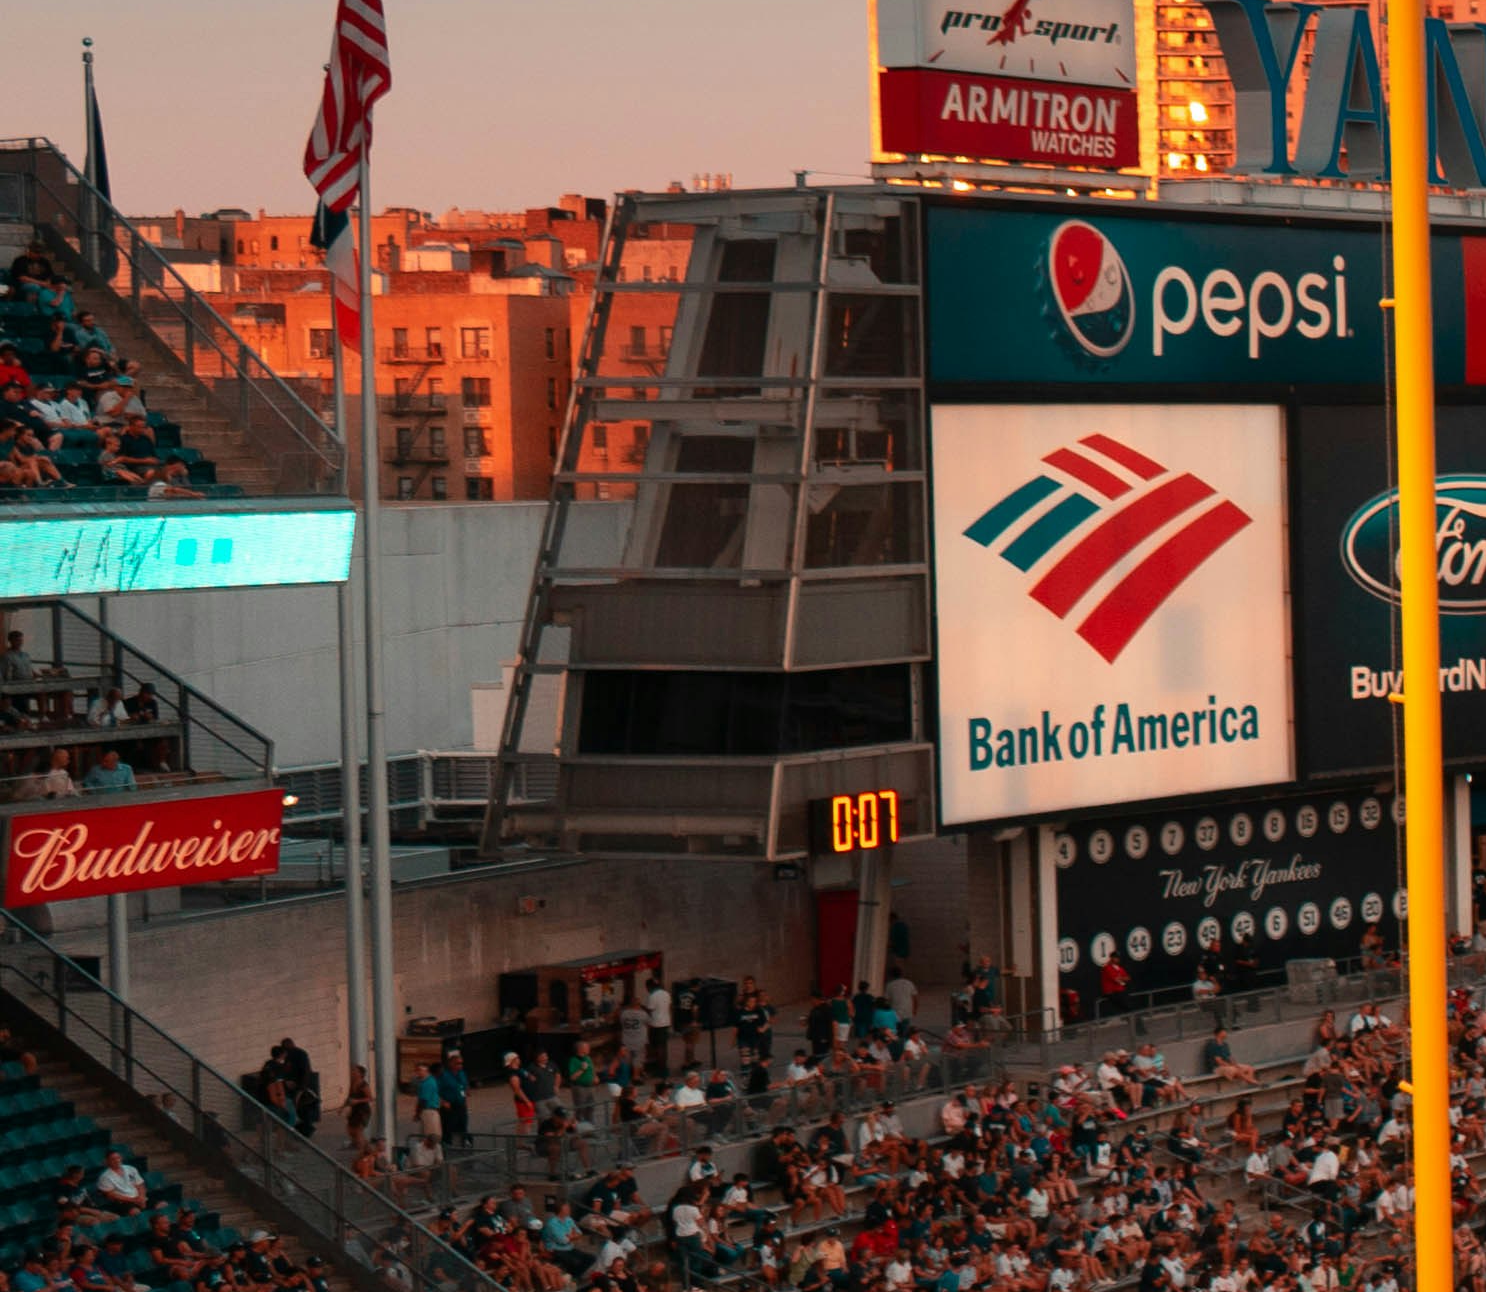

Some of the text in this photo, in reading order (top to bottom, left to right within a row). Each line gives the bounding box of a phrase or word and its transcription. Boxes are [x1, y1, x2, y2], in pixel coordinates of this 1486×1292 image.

[941, 83, 1116, 134] ARMITRON
[1031, 128, 1116, 159] WATCHES
[1152, 254, 1349, 359] pepsi
[967, 696, 1259, 771] Bank of America
[832, 790, 898, 852] 0:07
[14, 818, 281, 895] Budweiser
[1159, 852, 1322, 908] New York Yankees
